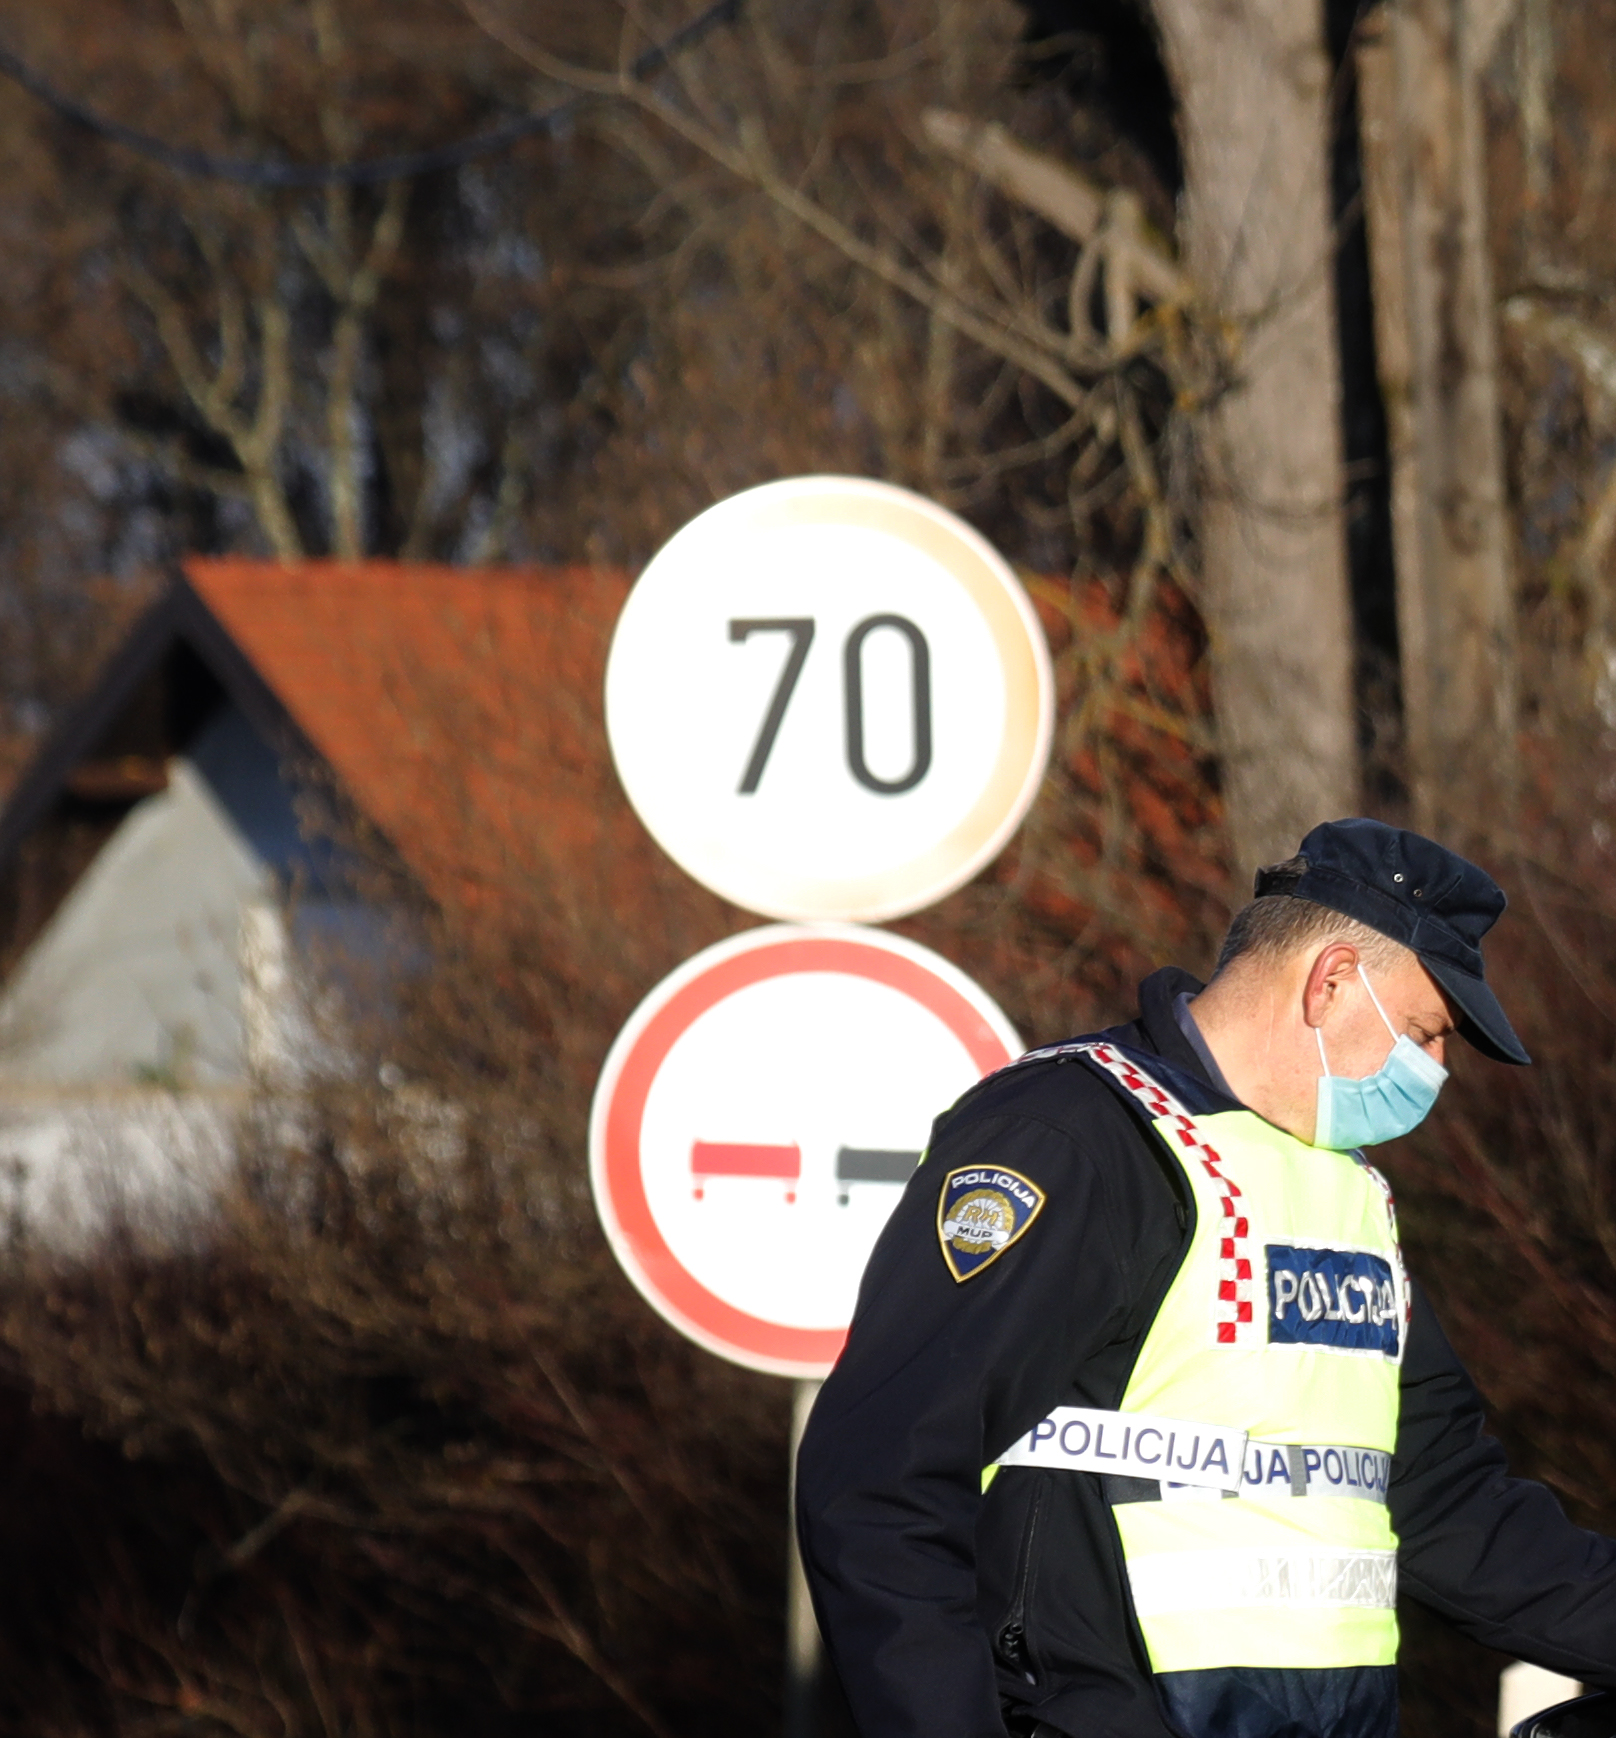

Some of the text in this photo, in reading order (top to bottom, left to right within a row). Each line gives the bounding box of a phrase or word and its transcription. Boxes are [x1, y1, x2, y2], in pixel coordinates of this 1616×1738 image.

[729, 613, 934, 797] 70
[951, 1171, 1036, 1209] POLICIJA
[956, 1225, 994, 1239] MUP
[964, 1205, 998, 1225] RH
[1273, 1269, 1396, 1331] POLICIJA
[1028, 1418, 1230, 1476] POLICIJA
